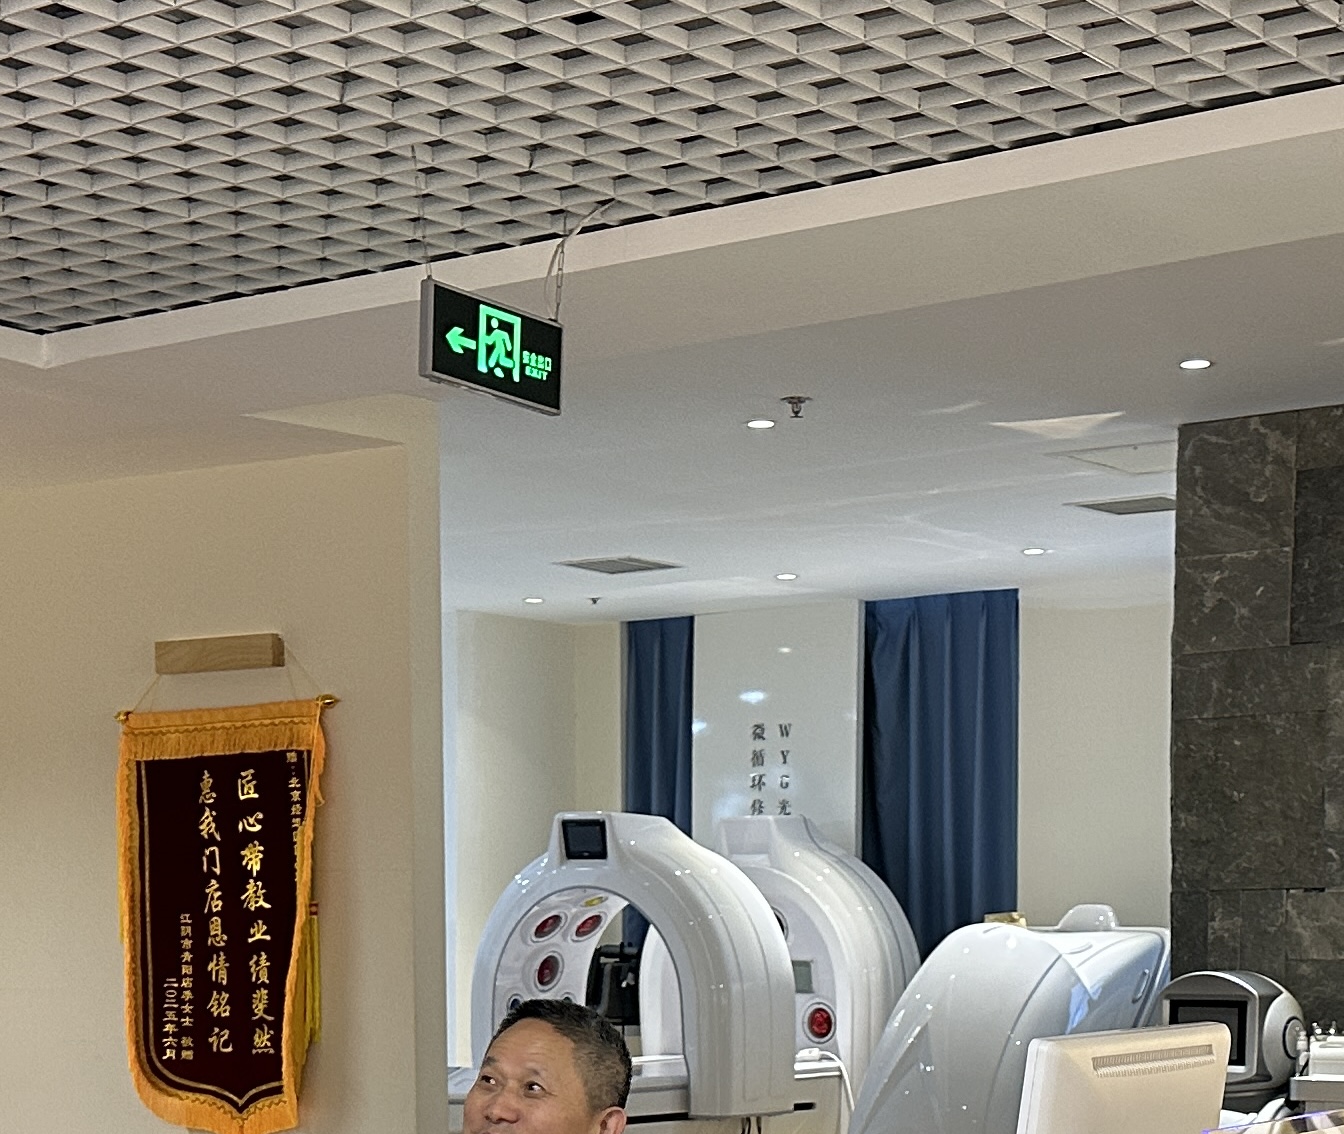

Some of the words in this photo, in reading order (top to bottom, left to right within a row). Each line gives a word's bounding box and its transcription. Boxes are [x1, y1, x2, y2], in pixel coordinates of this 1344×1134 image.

[524, 365, 548, 381] EXIT
[198, 769, 233, 1054] 惠我门店恩情铭记
[237, 769, 275, 1055] 匠心带教业绩斐然
